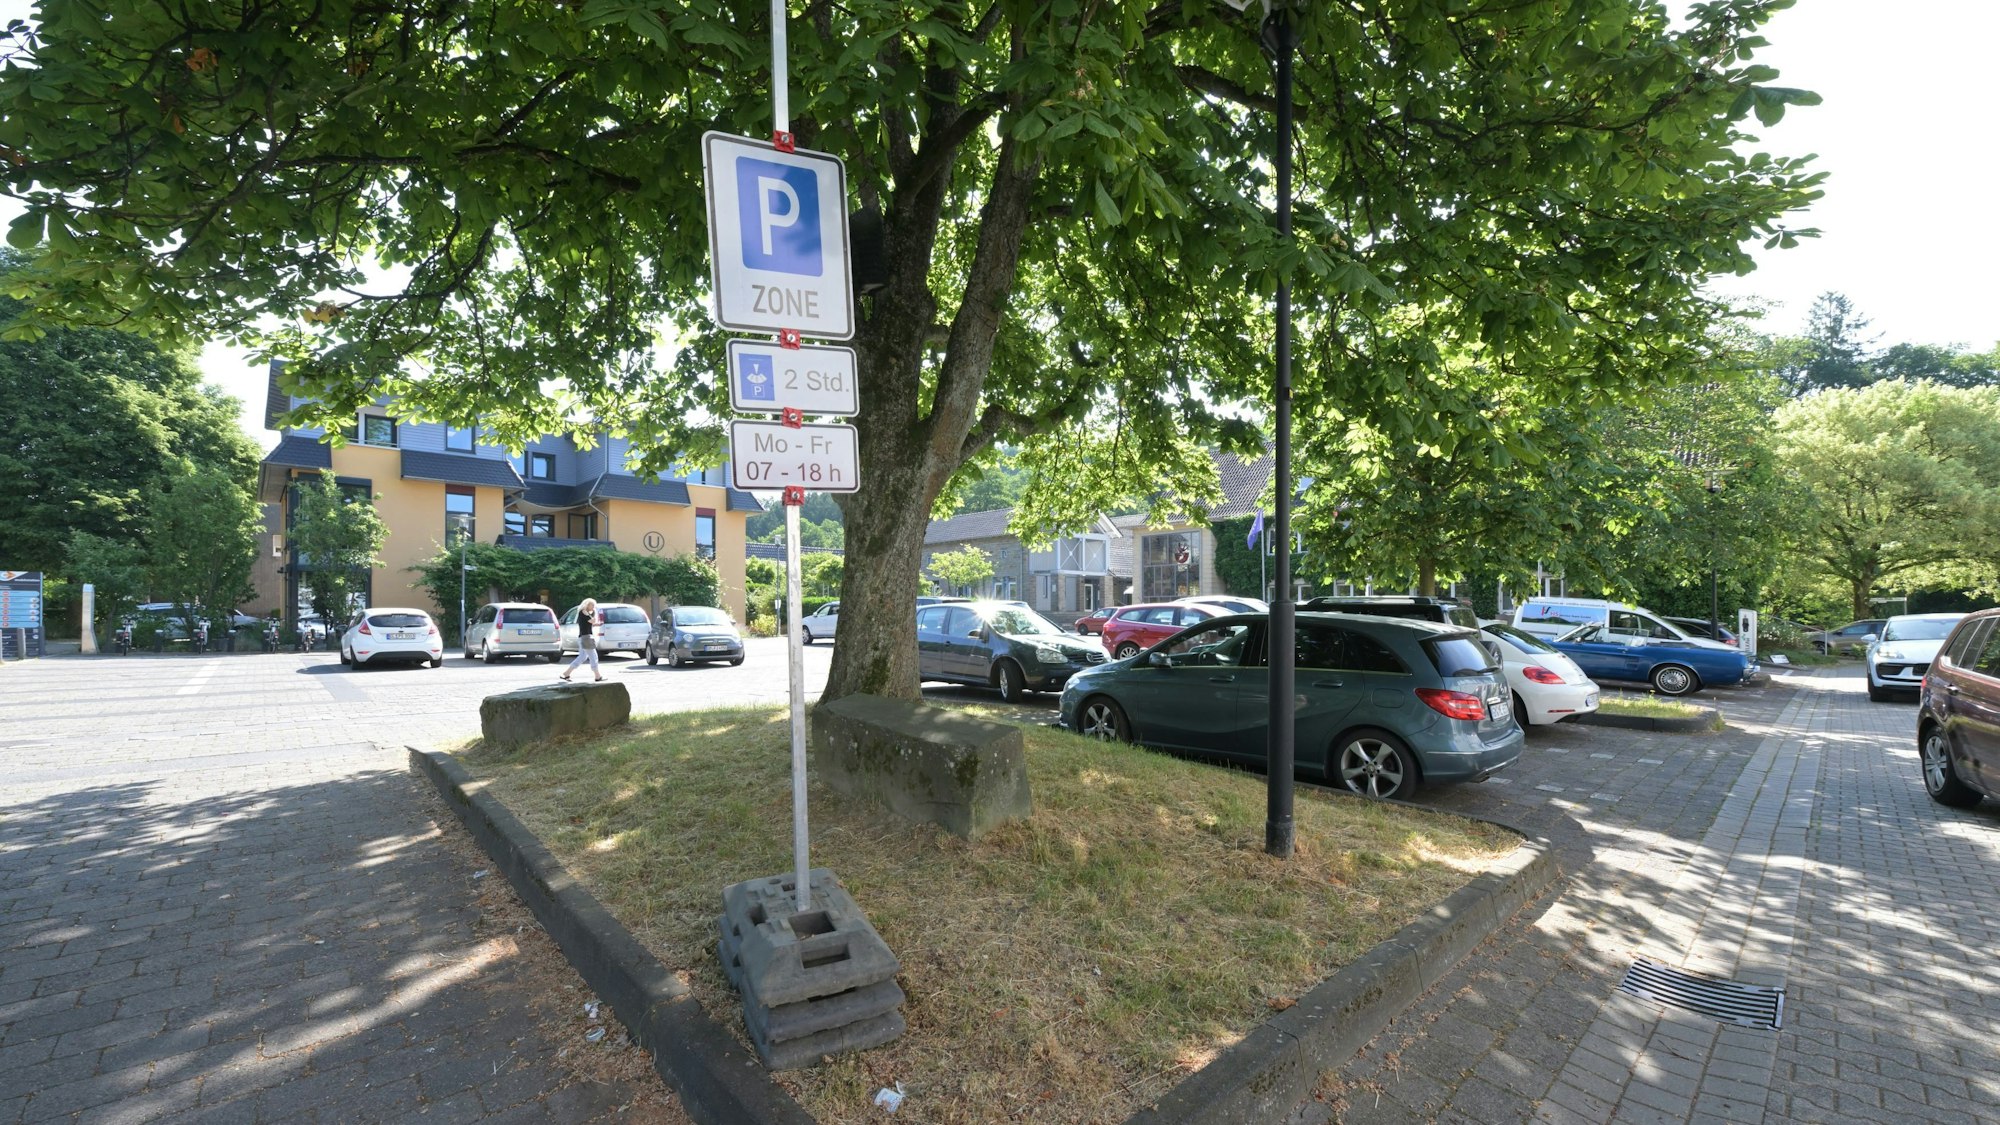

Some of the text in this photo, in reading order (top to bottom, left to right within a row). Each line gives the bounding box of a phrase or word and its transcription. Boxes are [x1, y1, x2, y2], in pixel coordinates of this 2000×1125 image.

[758, 176, 800, 256] P
[752, 285, 820, 319] ZONE
[754, 385, 762, 396] P
[784, 369, 849, 393] 2 Std.
[754, 433, 788, 453] Mo
[811, 435, 832, 455] Fr
[746, 461, 773, 481] 07
[797, 463, 822, 482] 18
[829, 463, 841, 482] h
[648, 535, 660, 549] U
